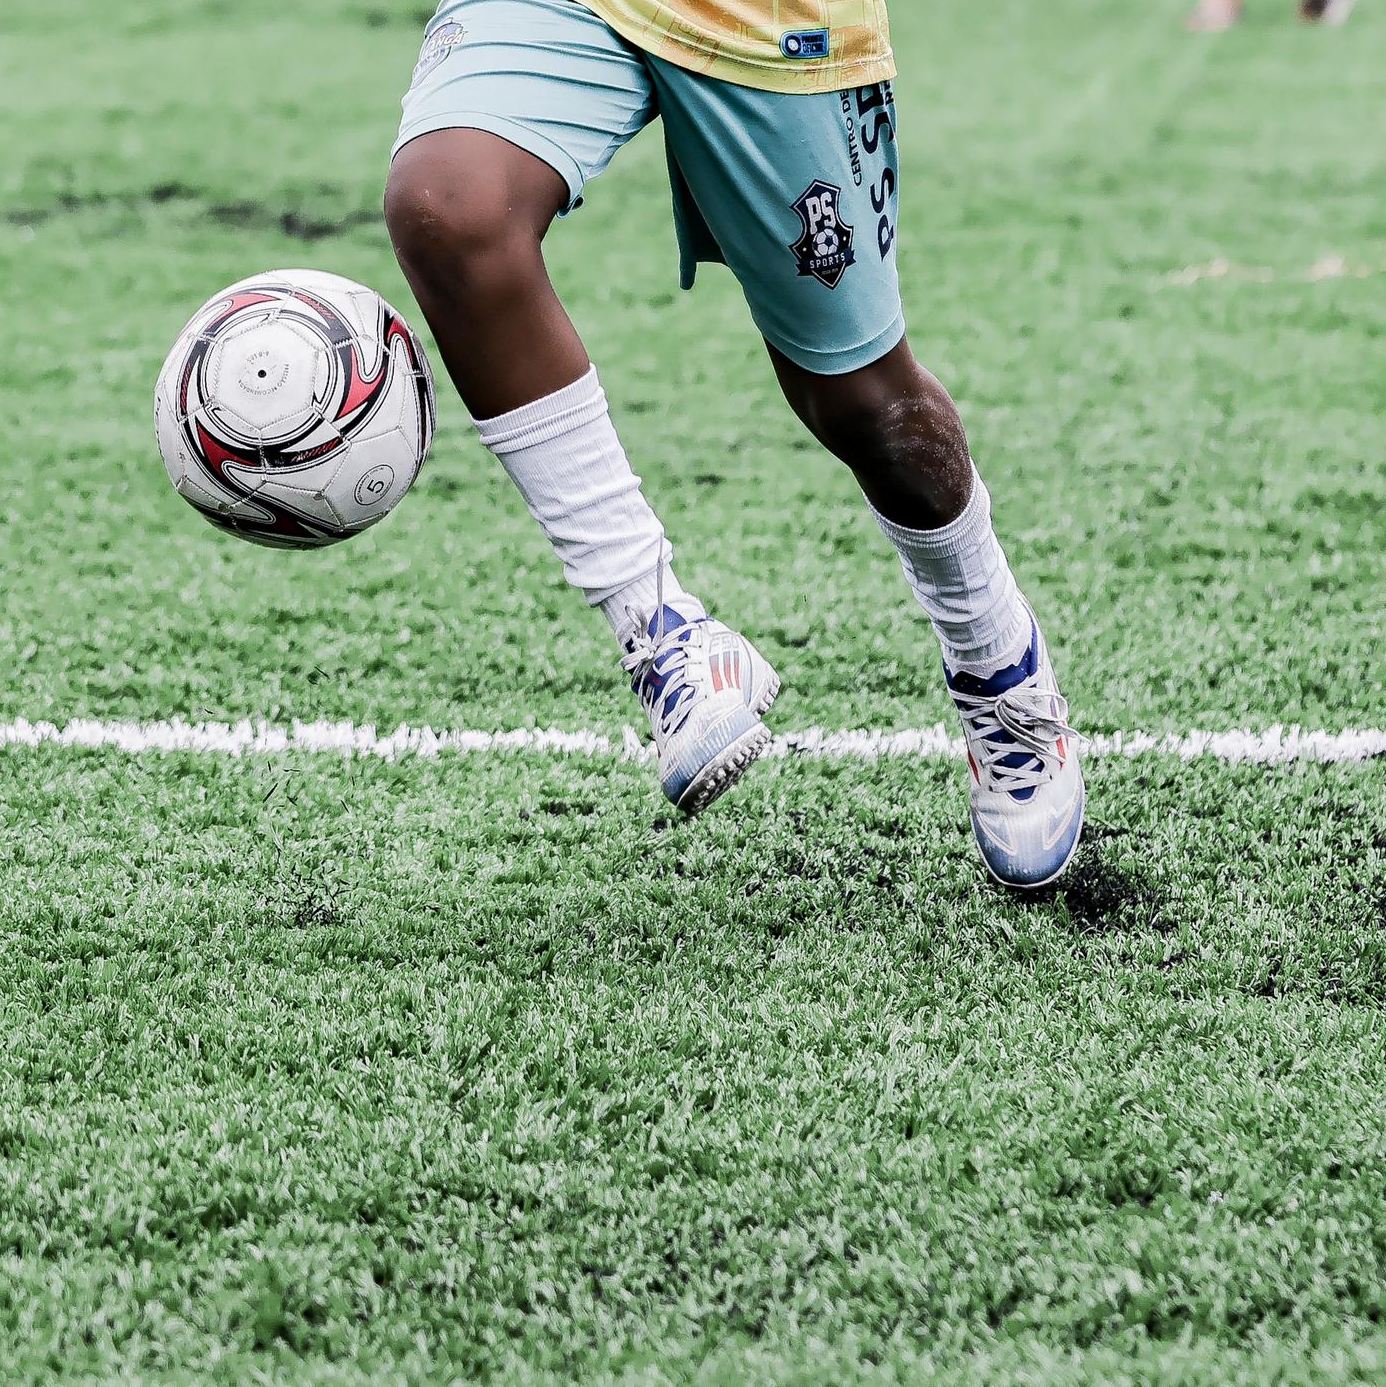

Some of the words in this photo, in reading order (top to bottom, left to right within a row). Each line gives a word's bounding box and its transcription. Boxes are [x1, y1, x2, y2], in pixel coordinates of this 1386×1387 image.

[840, 91, 851, 113] DE
[846, 116, 862, 187] CENTRO
[805, 191, 836, 235] PS
[809, 252, 846, 269] SPORTS
[366, 479, 385, 494] 5
